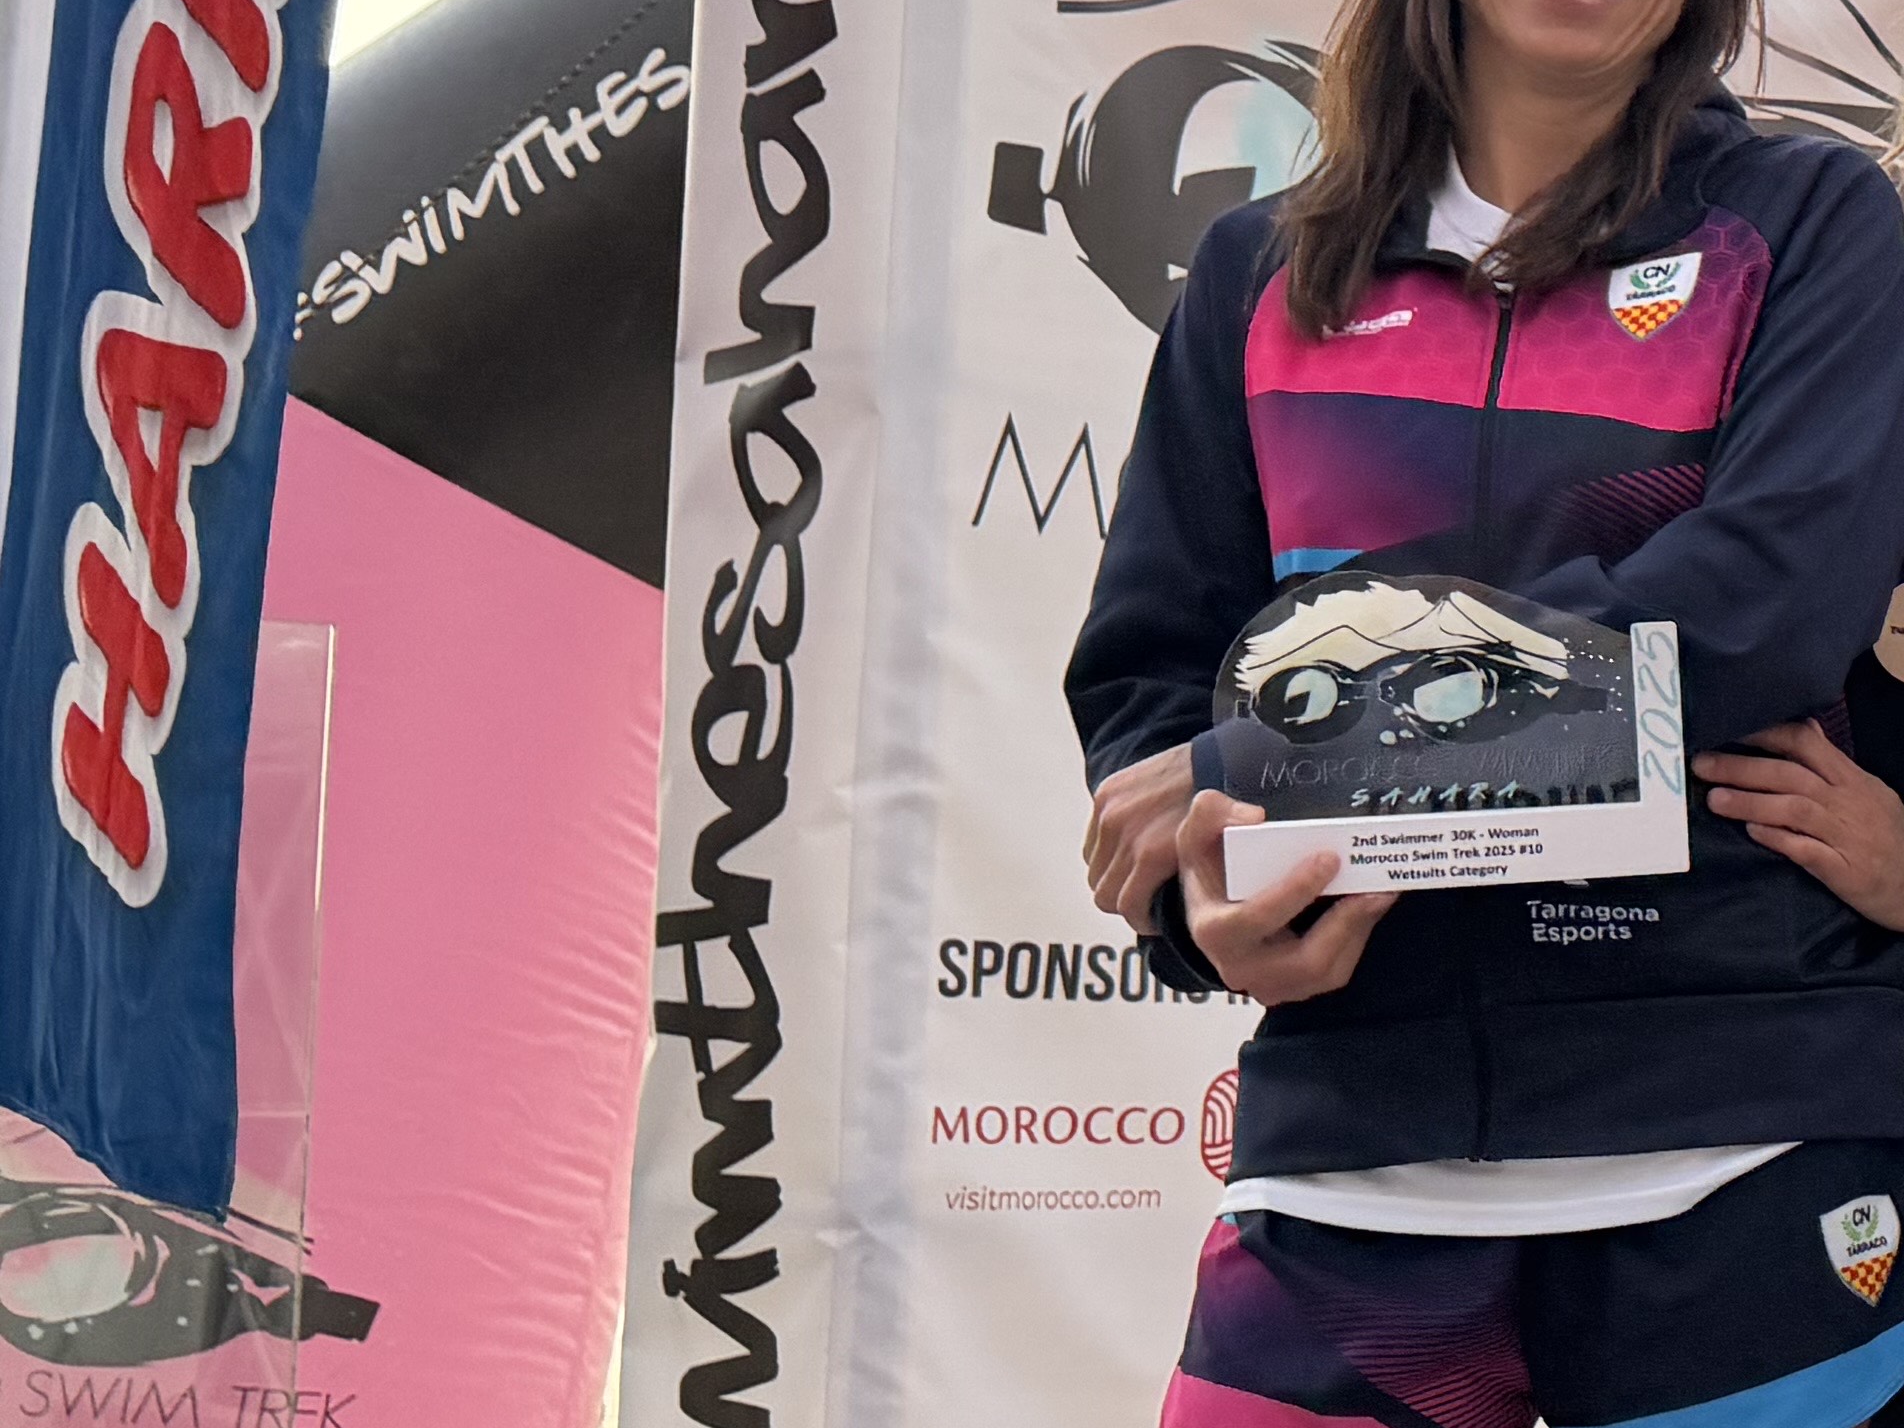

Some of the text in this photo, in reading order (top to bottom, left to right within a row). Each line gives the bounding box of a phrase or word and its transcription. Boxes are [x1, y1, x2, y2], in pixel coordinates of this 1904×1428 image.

[293, 47, 690, 340] SWIMTHES
[1643, 264, 1670, 279] CN
[1640, 628, 1681, 795] 2025
[1350, 779, 1524, 808] SAHARA
[1351, 835, 1377, 847] 2nd
[1380, 833, 1444, 846] Swimmer
[1451, 830, 1476, 841] 30K
[1488, 828, 1539, 839] Woman
[1350, 844, 1543, 865] Morocco Swim Trek 2025 #10
[1388, 864, 1508, 880] Wetsuits Category
[1527, 899, 1660, 925] Tarragona
[1532, 923, 1632, 948] Esports
[938, 938, 1211, 1004] SPONSO
[931, 1105, 1186, 1145] MOROCCO
[945, 1184, 1162, 1211] visitmorocco.com
